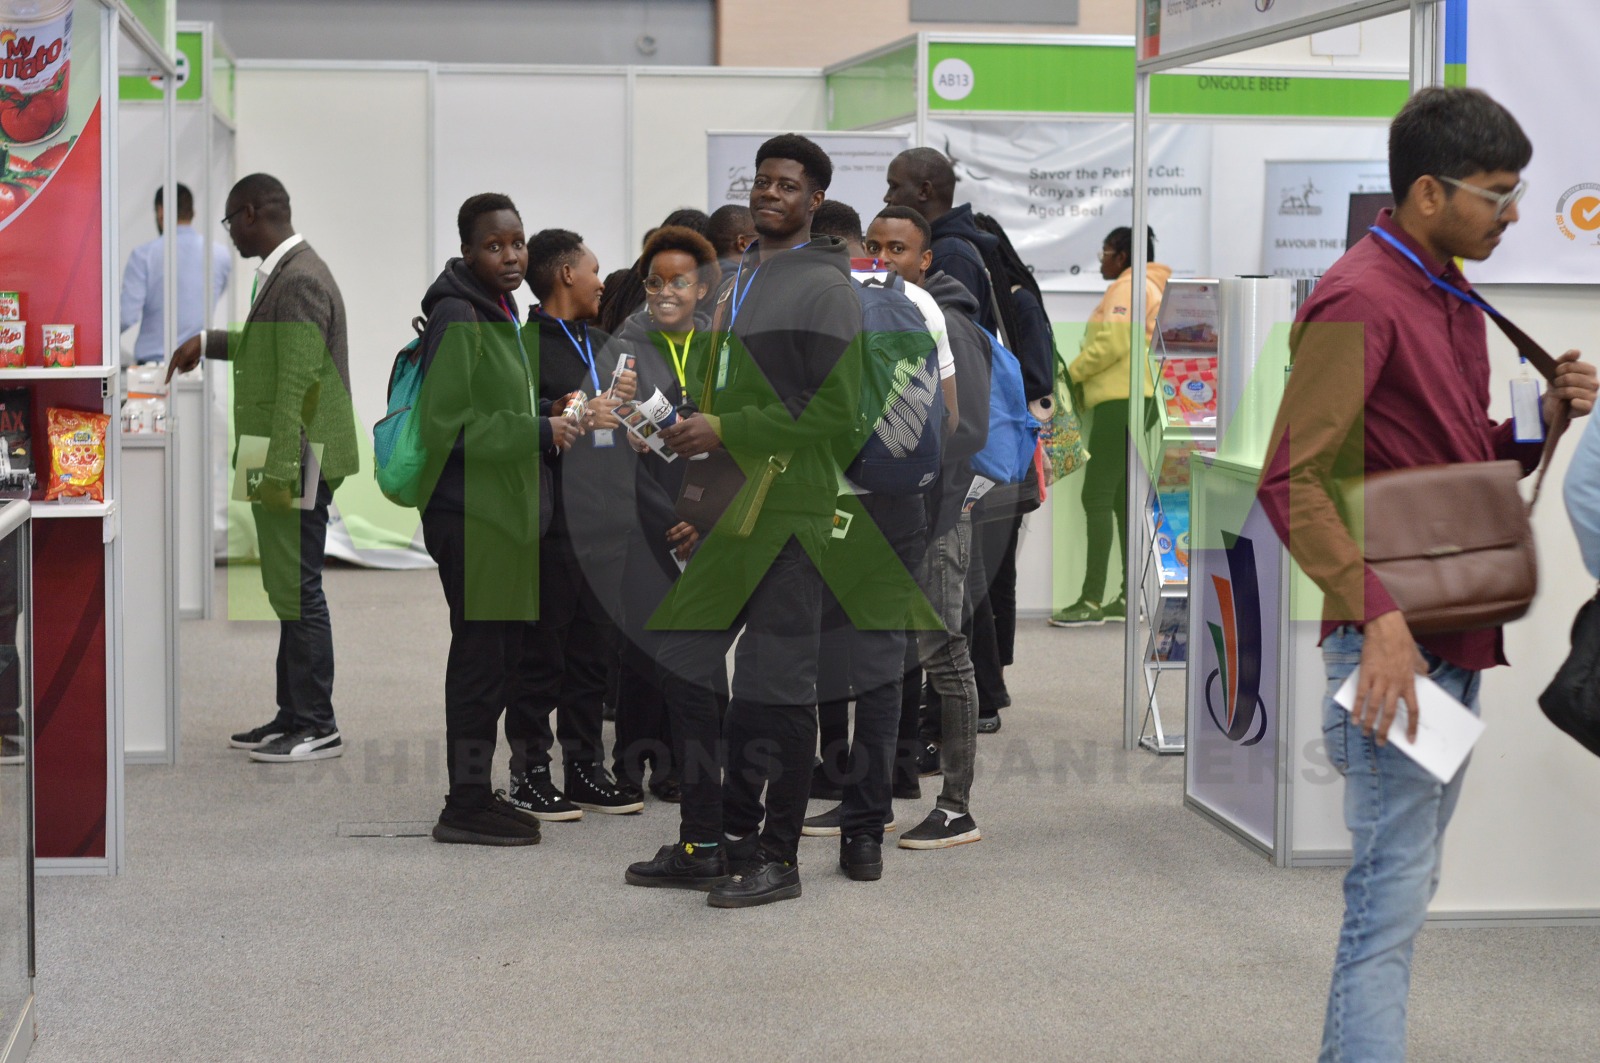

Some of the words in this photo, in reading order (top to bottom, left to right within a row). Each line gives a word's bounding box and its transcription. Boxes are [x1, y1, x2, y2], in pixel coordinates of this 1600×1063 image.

[938, 73, 969, 88] AB13
[1198, 76, 1255, 91] ONGOLE
[1259, 77, 1292, 92] BEEF
[1028, 167, 1072, 180] Savor
[1076, 168, 1098, 180] the
[1102, 167, 1154, 180] Perft
[1155, 165, 1185, 178] Cut:
[1027, 185, 1085, 201] Kenya's
[1142, 185, 1202, 198] remium
[1027, 204, 1065, 219] Aged
[1070, 204, 1104, 217] Beef
[1275, 239, 1317, 249] SAVOUR
[1319, 239, 1337, 249] THE
